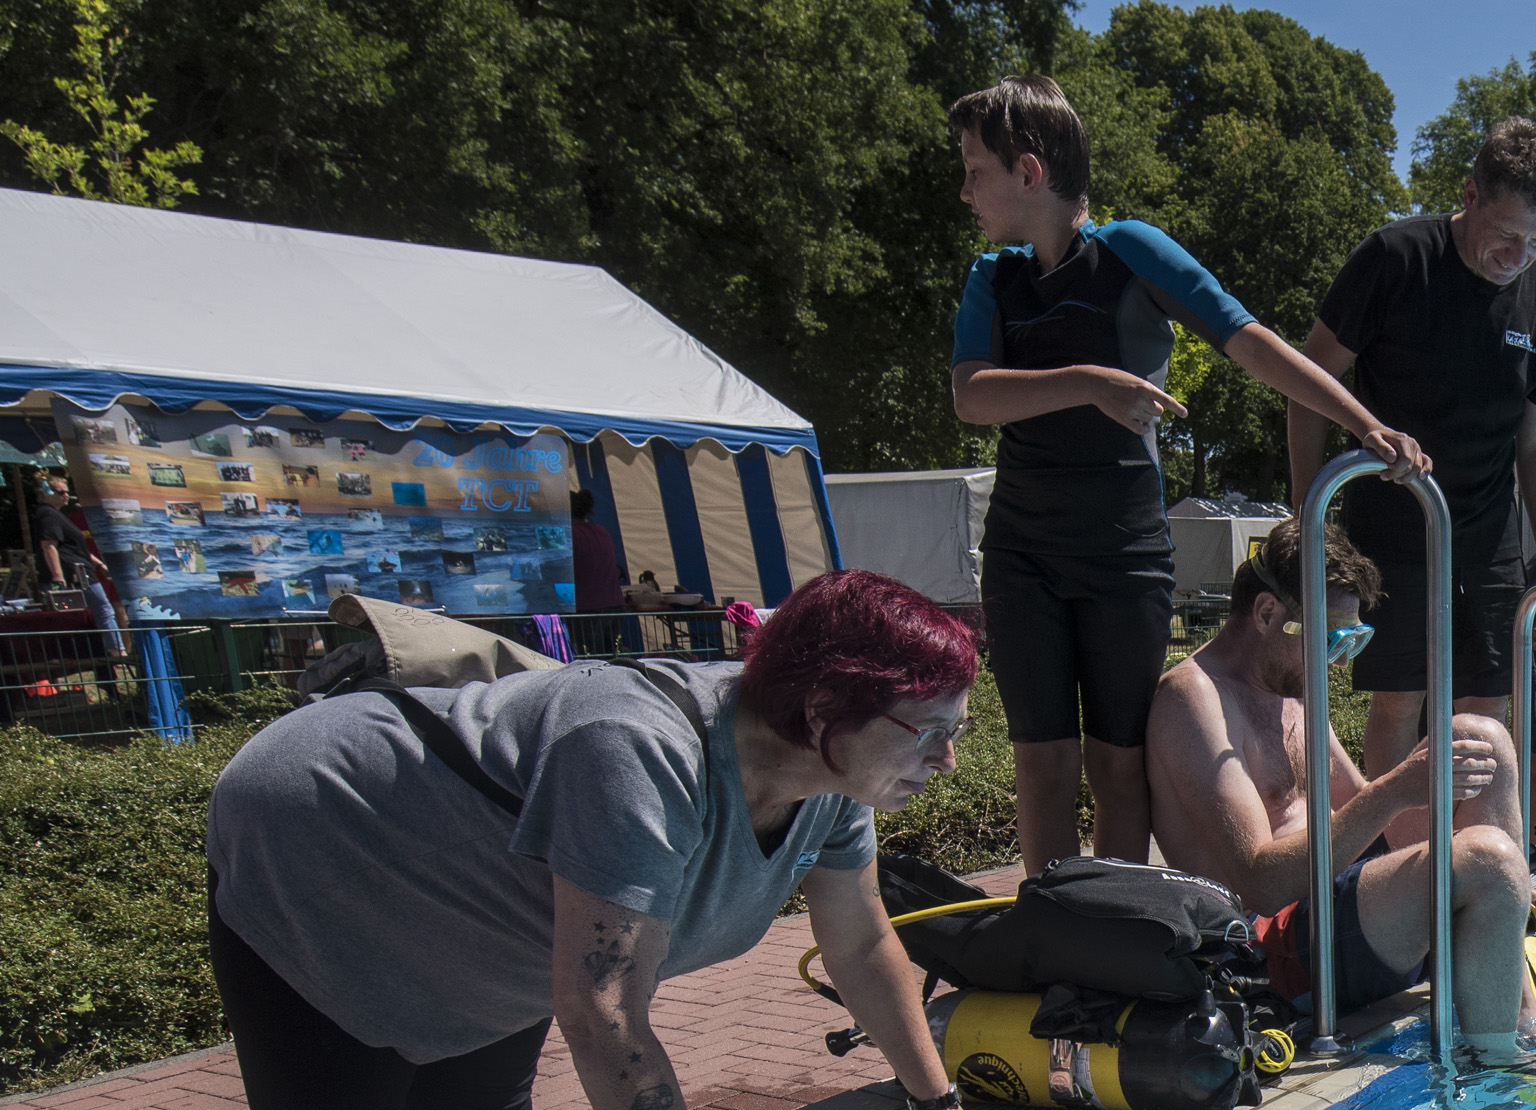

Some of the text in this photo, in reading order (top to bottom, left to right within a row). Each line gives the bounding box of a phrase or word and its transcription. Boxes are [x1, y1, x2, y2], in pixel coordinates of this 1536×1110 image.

[412, 433, 563, 474] 20 Jahre
[457, 477, 539, 512] TCT
